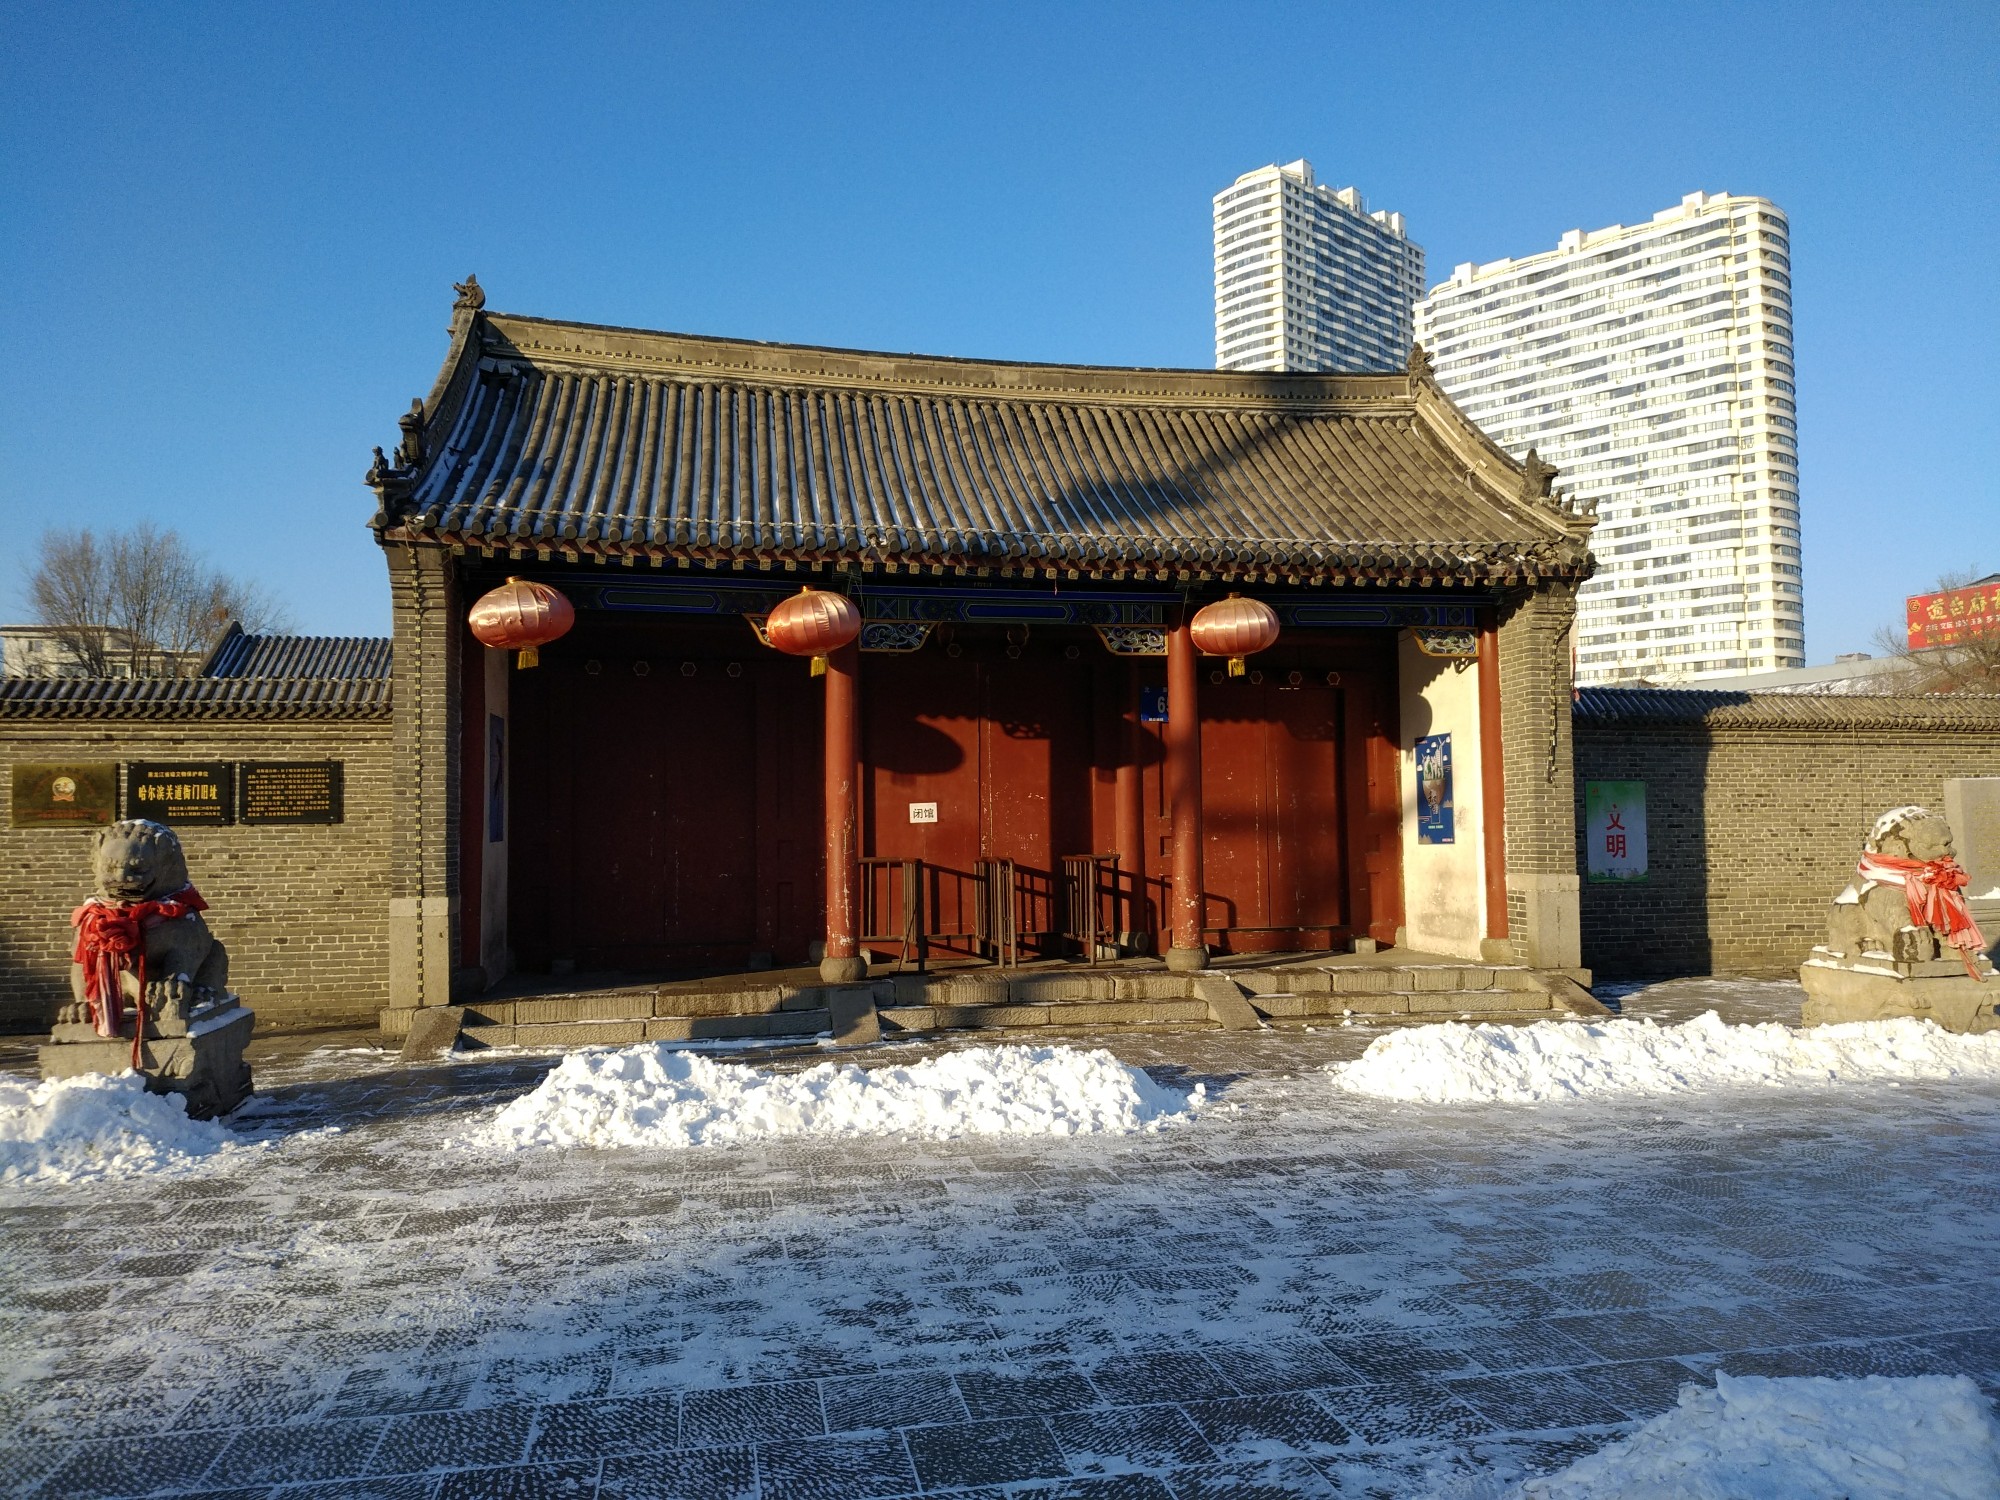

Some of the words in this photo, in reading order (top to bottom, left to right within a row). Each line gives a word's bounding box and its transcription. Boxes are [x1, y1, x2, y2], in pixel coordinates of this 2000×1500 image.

[138, 784, 218, 801] 哈尔滨关道衙门旧址
[913, 808, 934, 819] 闭馆
[1606, 804, 1627, 858] 文明
